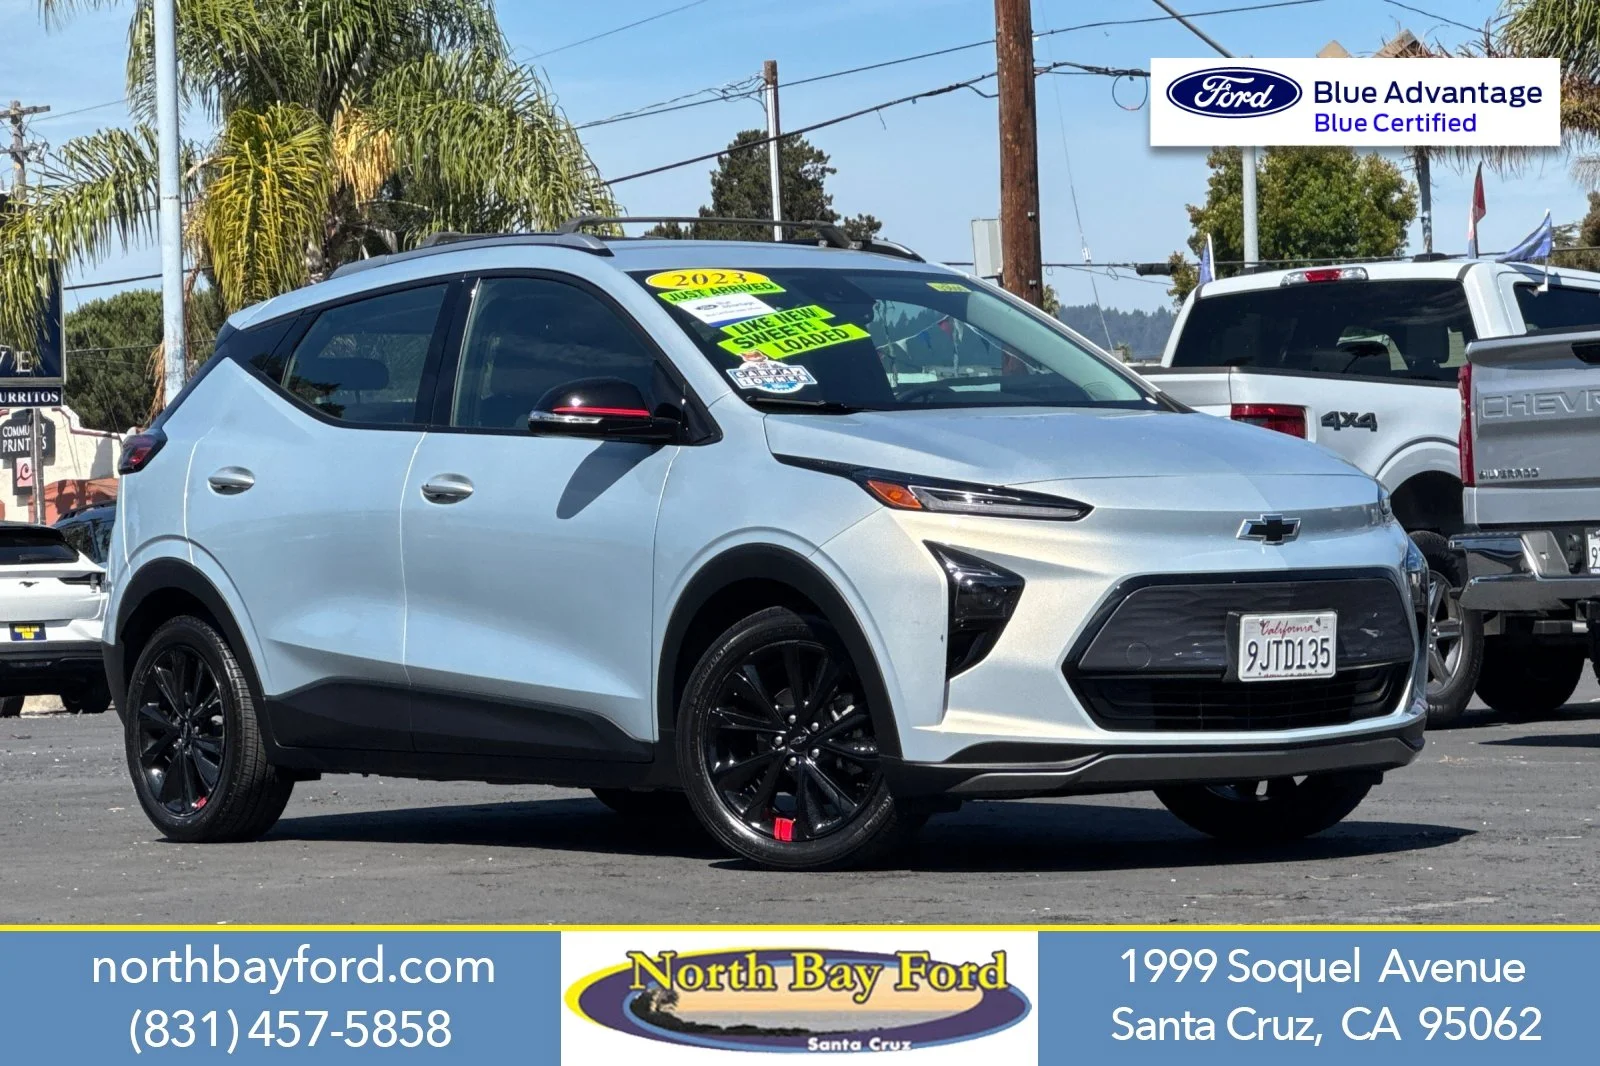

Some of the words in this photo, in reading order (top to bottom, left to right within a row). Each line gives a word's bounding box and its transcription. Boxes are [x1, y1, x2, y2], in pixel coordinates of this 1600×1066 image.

[672, 272, 748, 287] 2023
[667, 288, 706, 302] JUST
[708, 281, 775, 297] ARRIVED
[732, 313, 772, 334] LIKE
[775, 307, 819, 324] NEW
[732, 320, 815, 349] SWEET!
[773, 328, 851, 354] LOADED
[2, 423, 47, 438] COMMUY
[2, 436, 47, 453] PRINTS
[1260, 620, 1320, 639] California
[1246, 637, 1331, 672] 9JTD135
